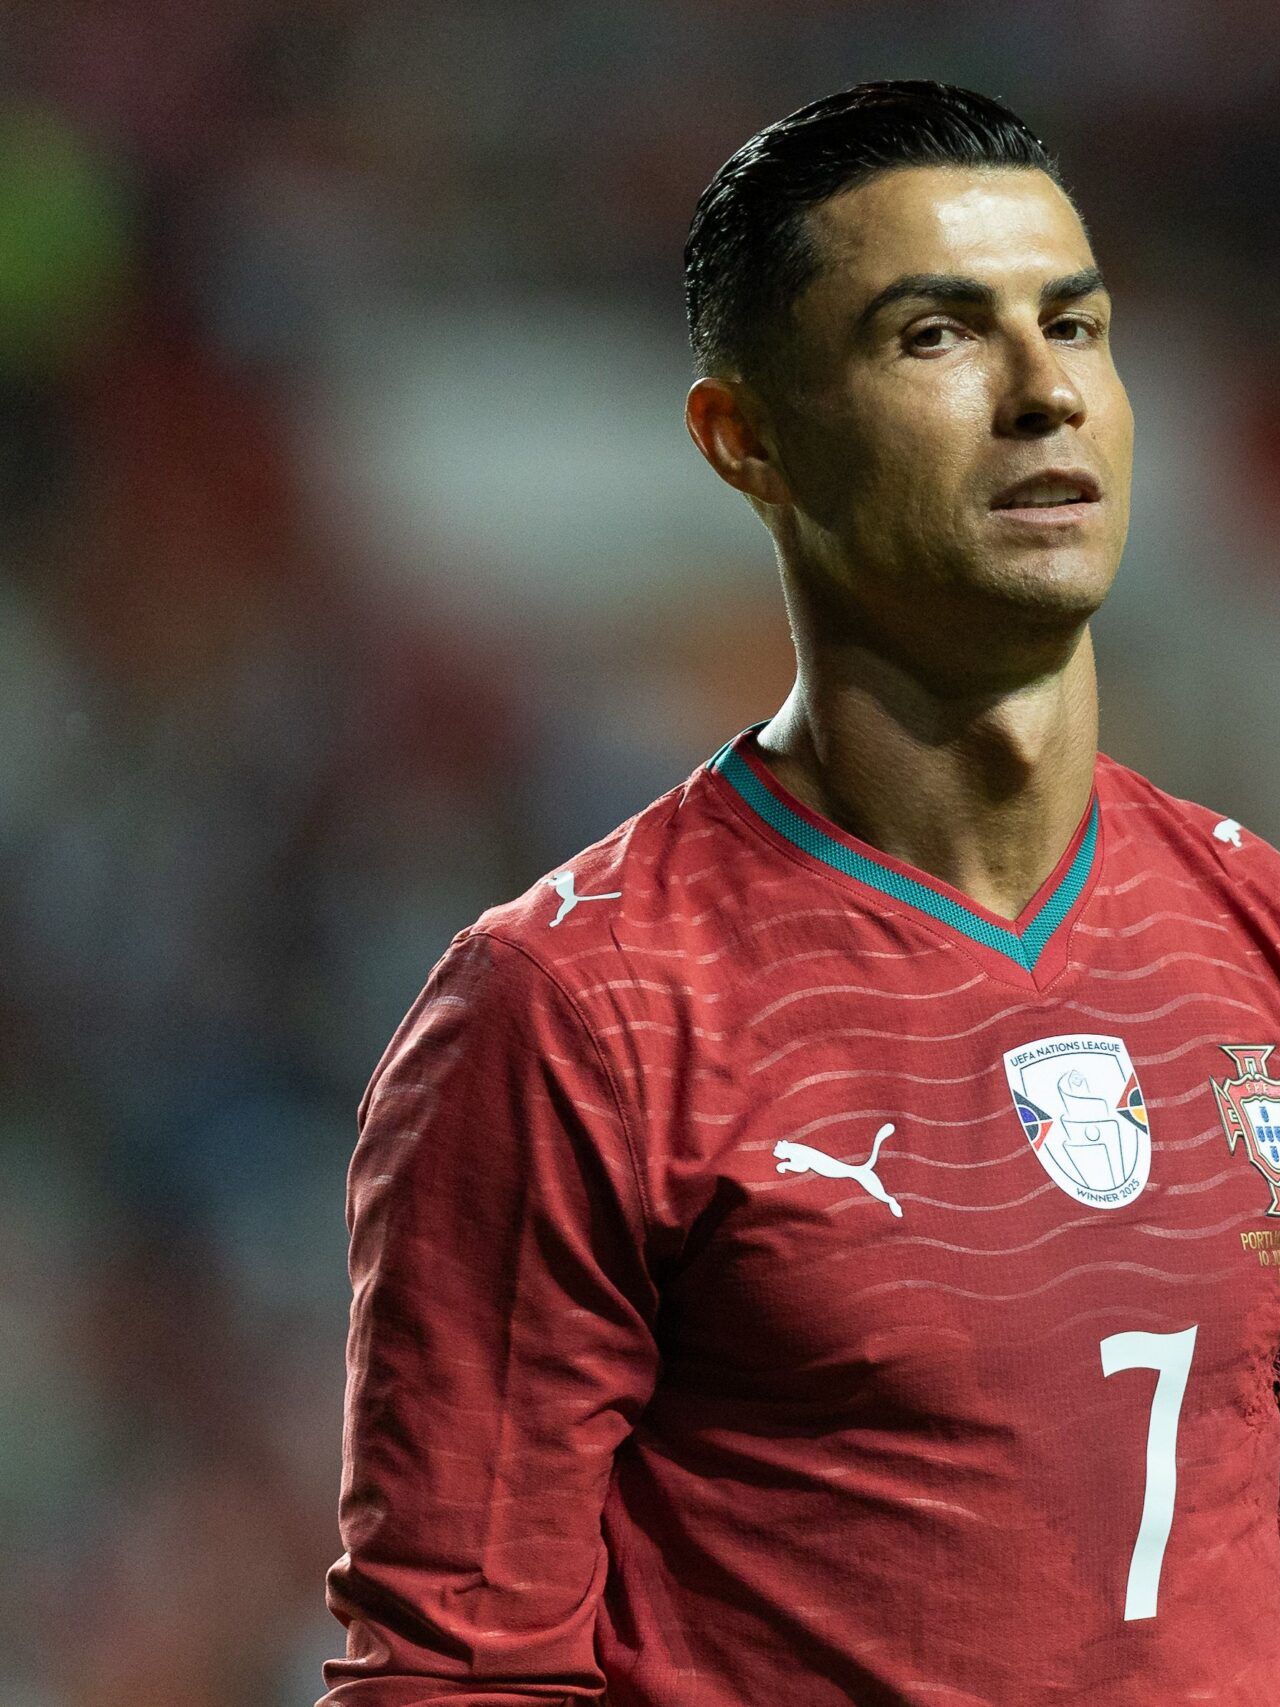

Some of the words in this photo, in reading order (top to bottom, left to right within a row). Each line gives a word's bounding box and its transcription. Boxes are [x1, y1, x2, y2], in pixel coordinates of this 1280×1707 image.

[1010, 1051, 1035, 1067] UEFA
[1037, 1041, 1080, 1057] NATIONS
[1082, 1041, 1121, 1052] LEAGUE
[1076, 1187, 1120, 1203] WINNER
[1119, 1178, 1140, 1198] 2025
[1258, 1250, 1269, 1267] 10
[1099, 1323, 1199, 1622] 7
